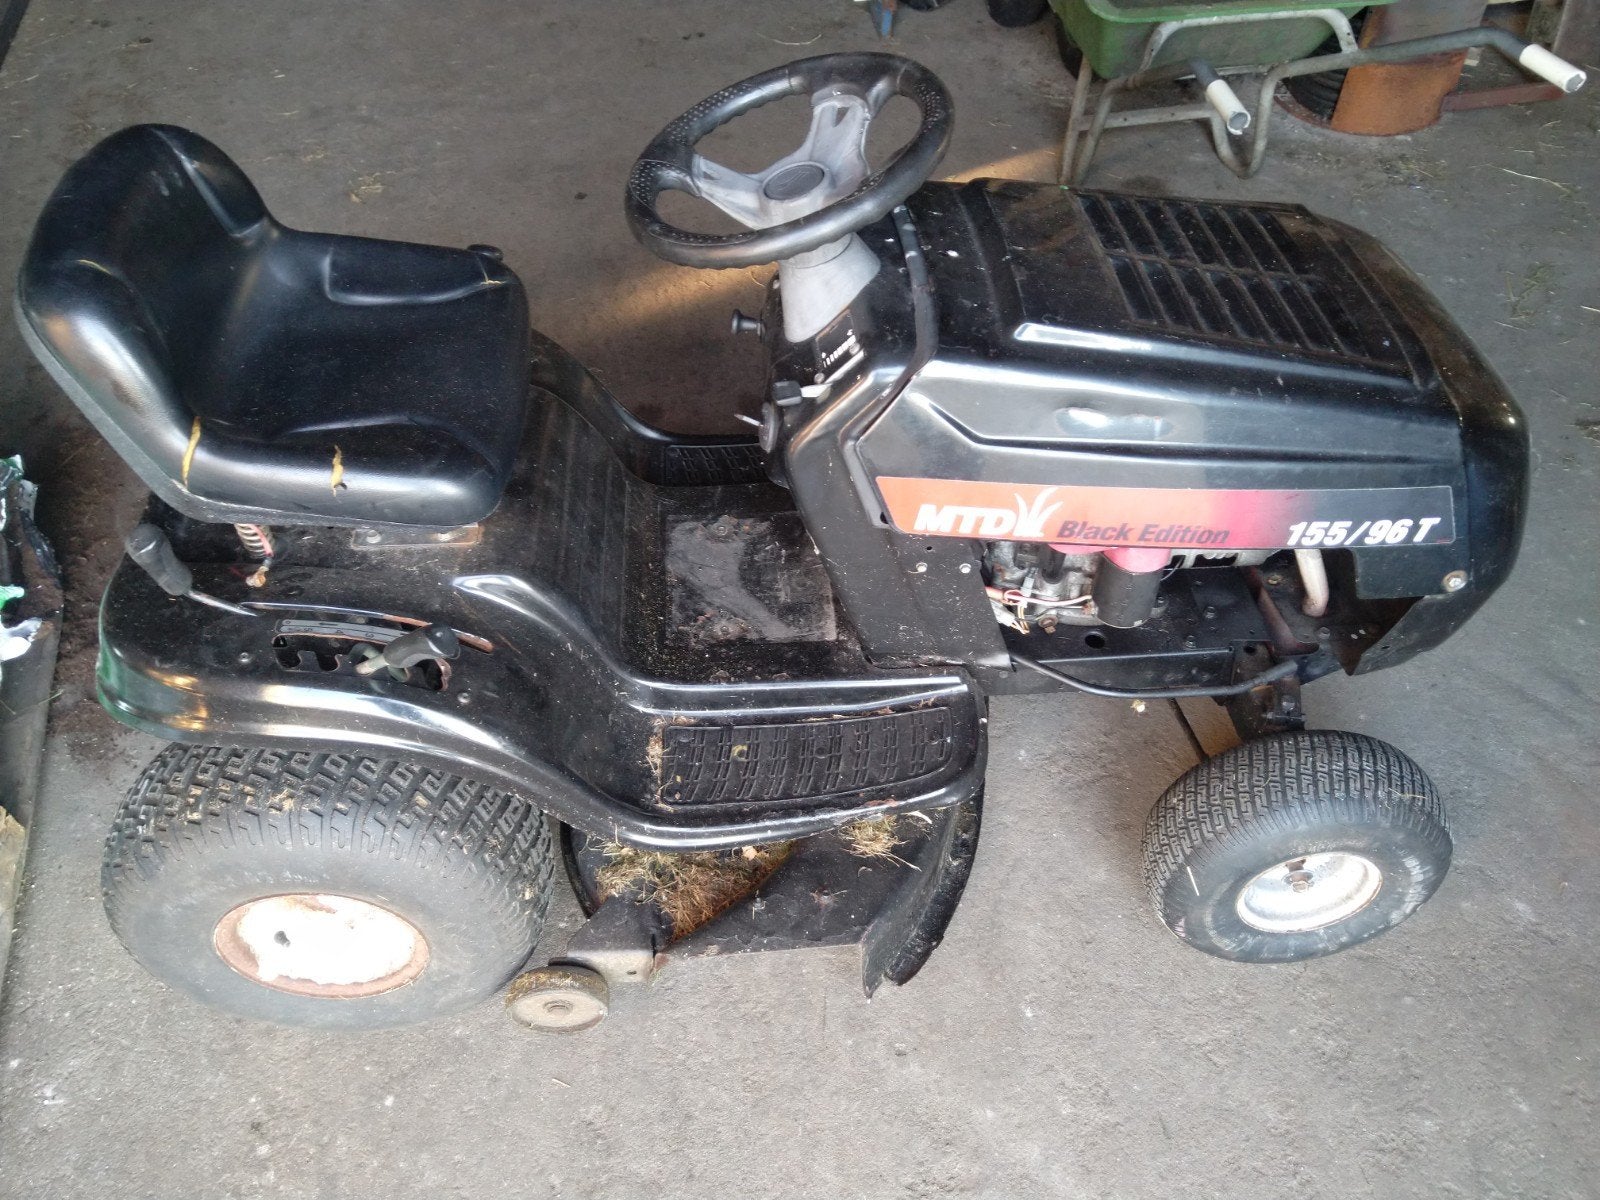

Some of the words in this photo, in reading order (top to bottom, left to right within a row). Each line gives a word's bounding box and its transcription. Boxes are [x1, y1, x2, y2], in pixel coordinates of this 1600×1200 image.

[915, 503, 1018, 537] MTD
[1058, 521, 1133, 544] Black
[1137, 524, 1230, 547] Edition
[1287, 519, 1413, 547] 155/96
[1413, 517, 1441, 543] T
